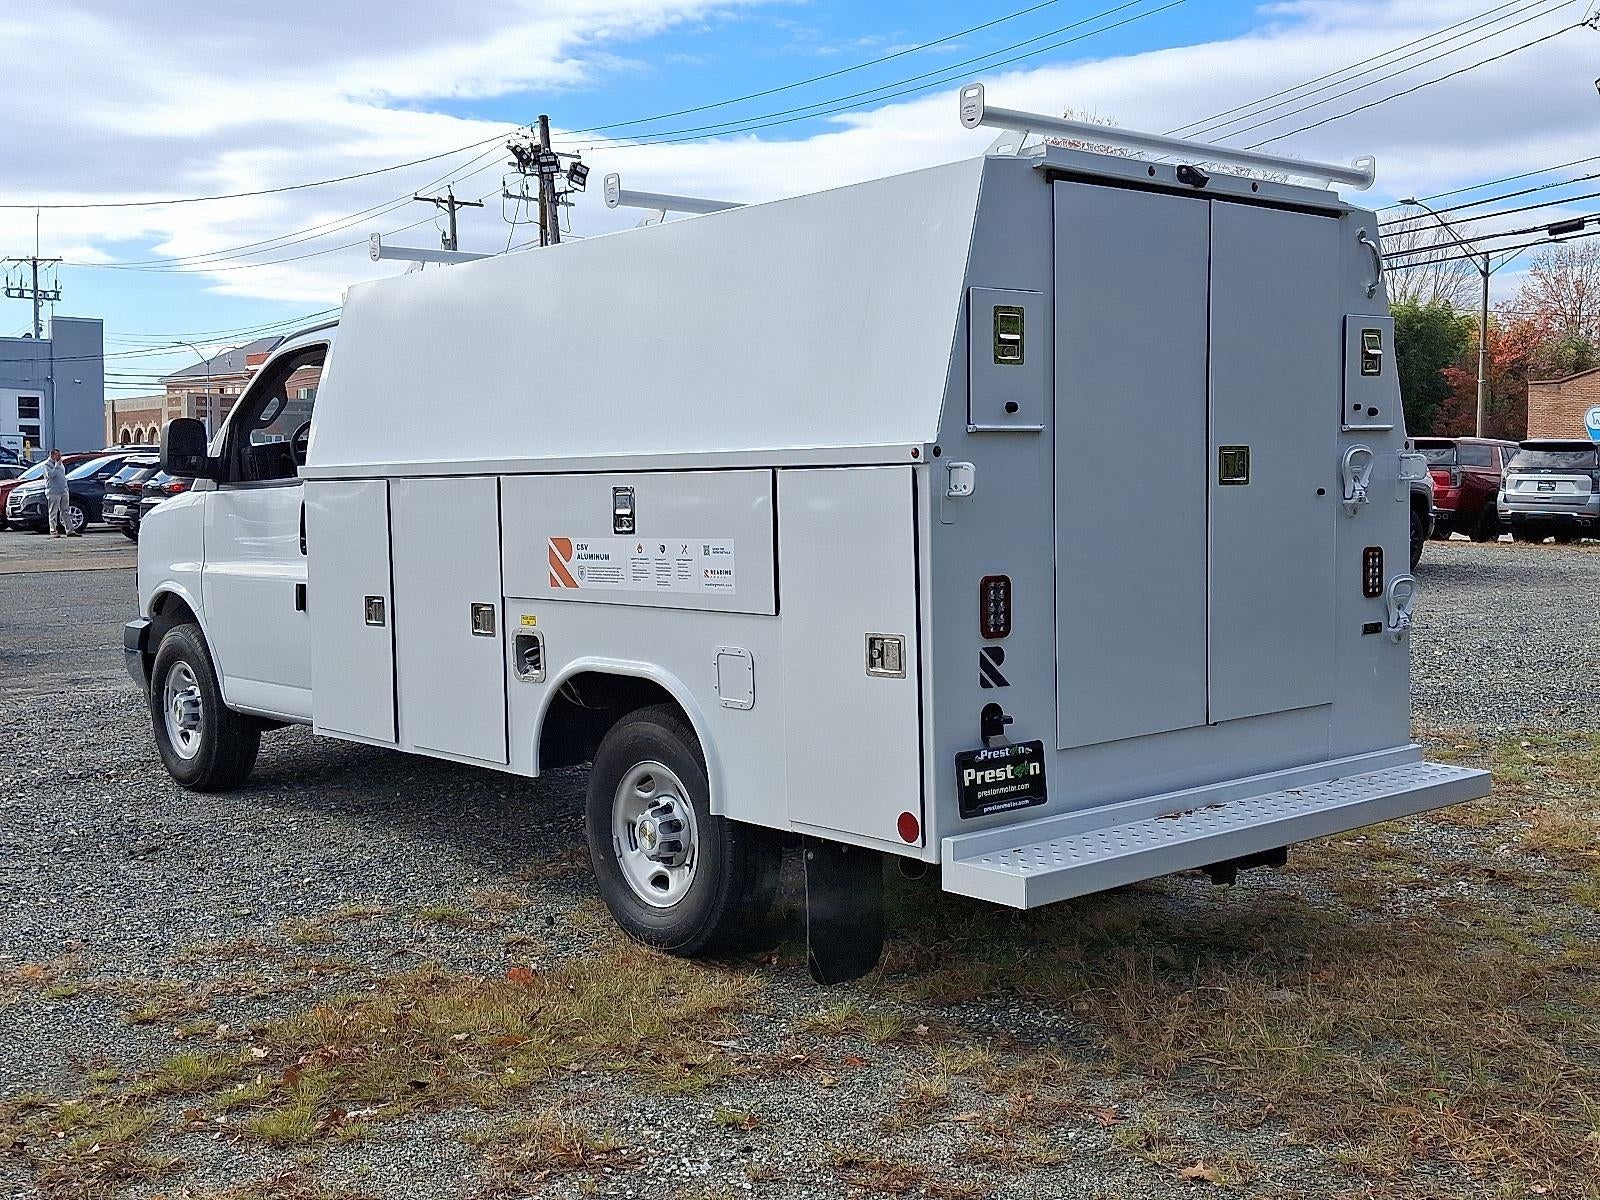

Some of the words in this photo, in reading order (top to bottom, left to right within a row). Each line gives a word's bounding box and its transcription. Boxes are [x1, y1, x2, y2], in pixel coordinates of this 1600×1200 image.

[576, 543, 589, 551] CSV
[980, 745, 1025, 760] Preston
[963, 760, 1041, 787] Preston
[977, 783, 1030, 800] prestonmotor.com
